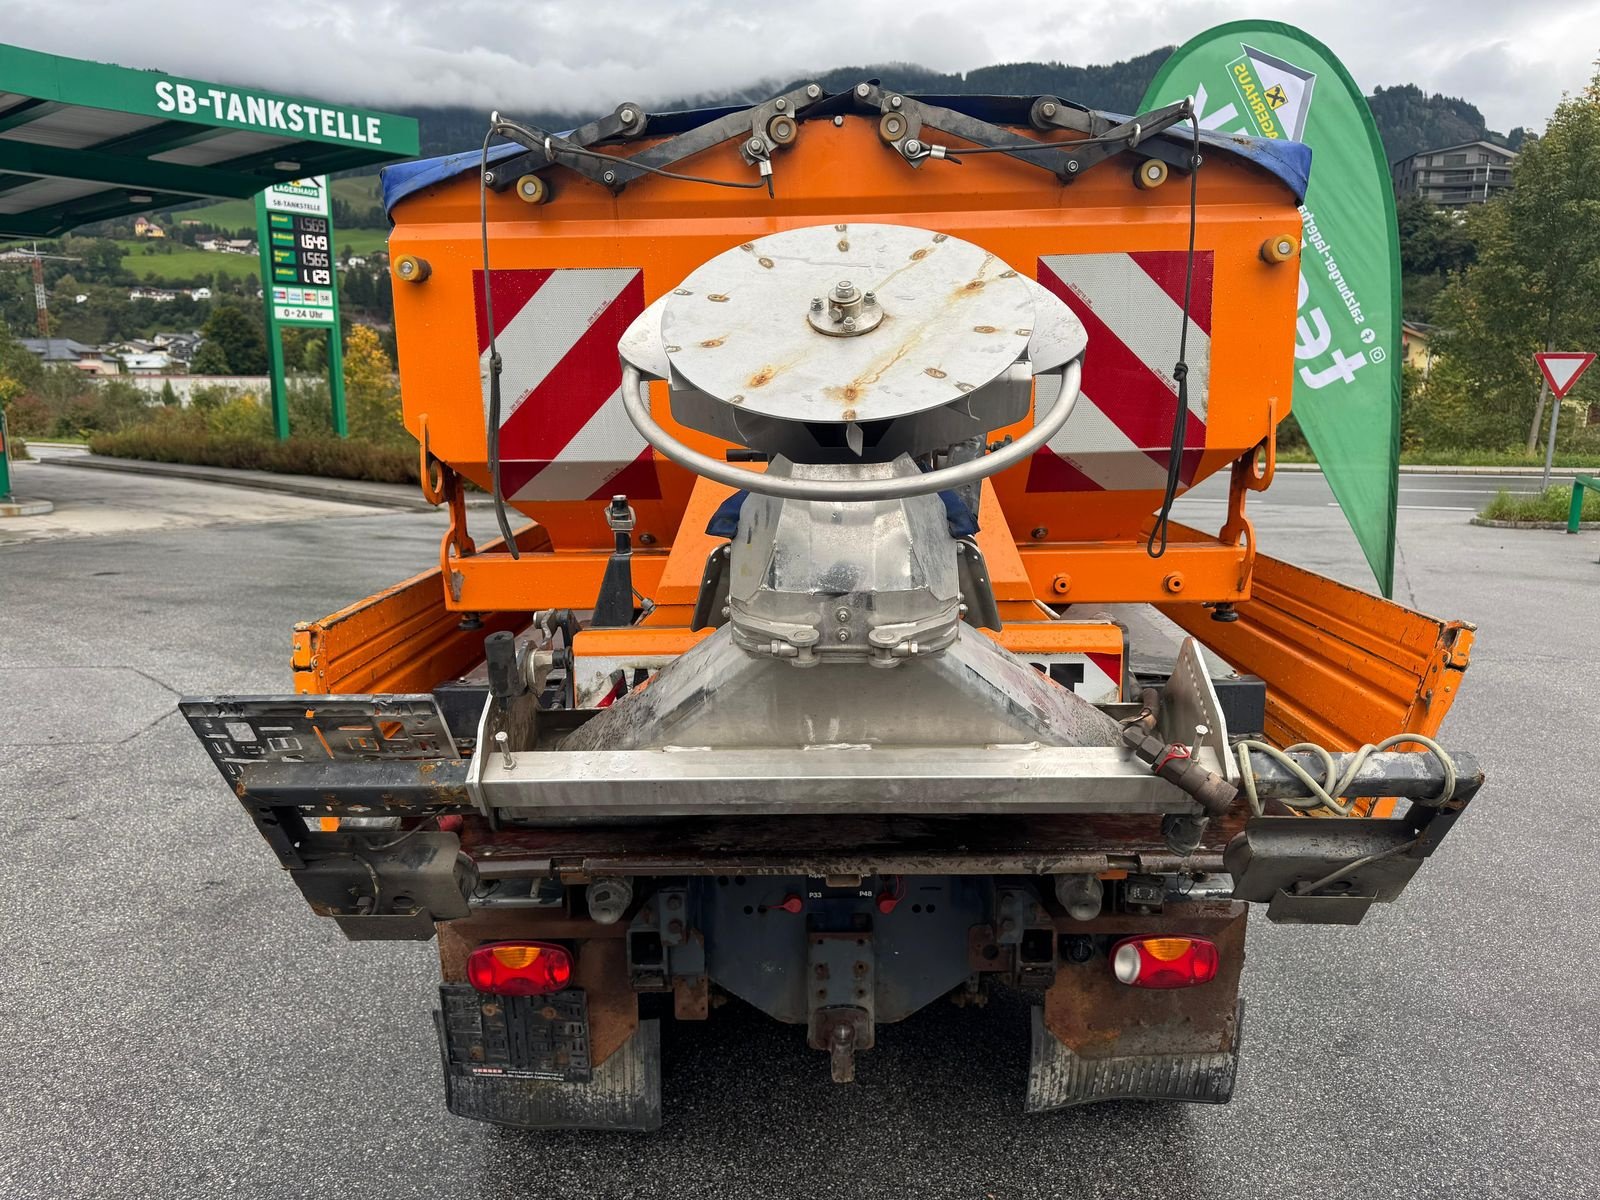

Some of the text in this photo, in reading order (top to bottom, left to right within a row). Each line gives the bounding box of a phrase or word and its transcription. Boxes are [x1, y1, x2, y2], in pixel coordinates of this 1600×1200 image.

[155, 81, 382, 144] SB-TANKSTELLE
[274, 184, 318, 196] LAGERHAUS
[273, 199, 320, 211] SB-TANKSTELLE
[309, 311, 323, 319] Uhr
